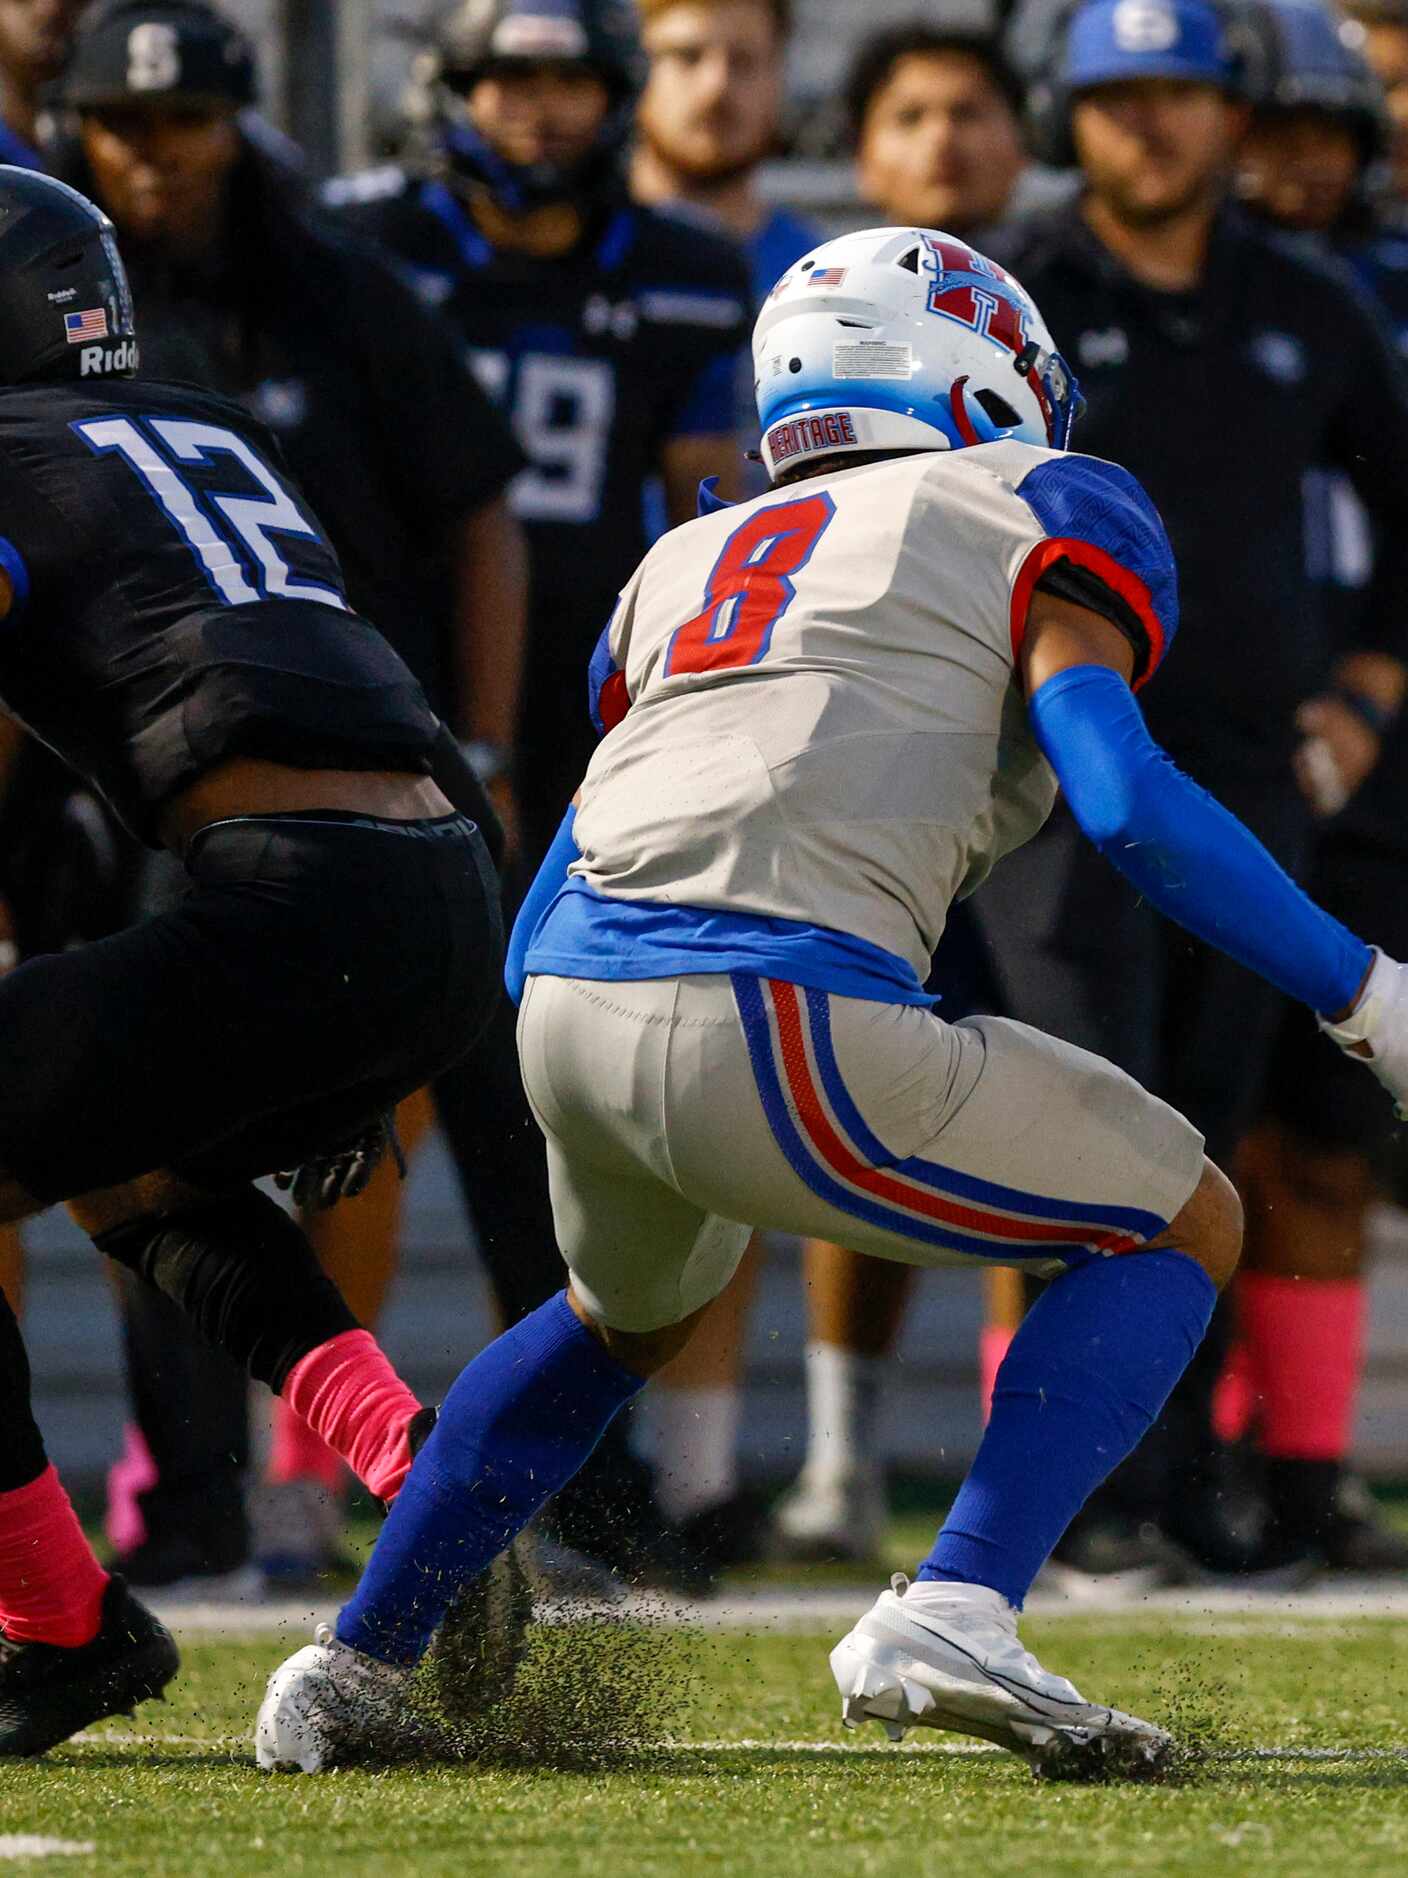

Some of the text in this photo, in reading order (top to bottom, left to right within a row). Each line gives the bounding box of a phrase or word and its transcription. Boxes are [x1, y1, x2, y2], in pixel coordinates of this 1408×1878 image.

[68, 413, 353, 611] 12
[767, 412, 858, 465] HERITAGE
[663, 490, 837, 678] 8
